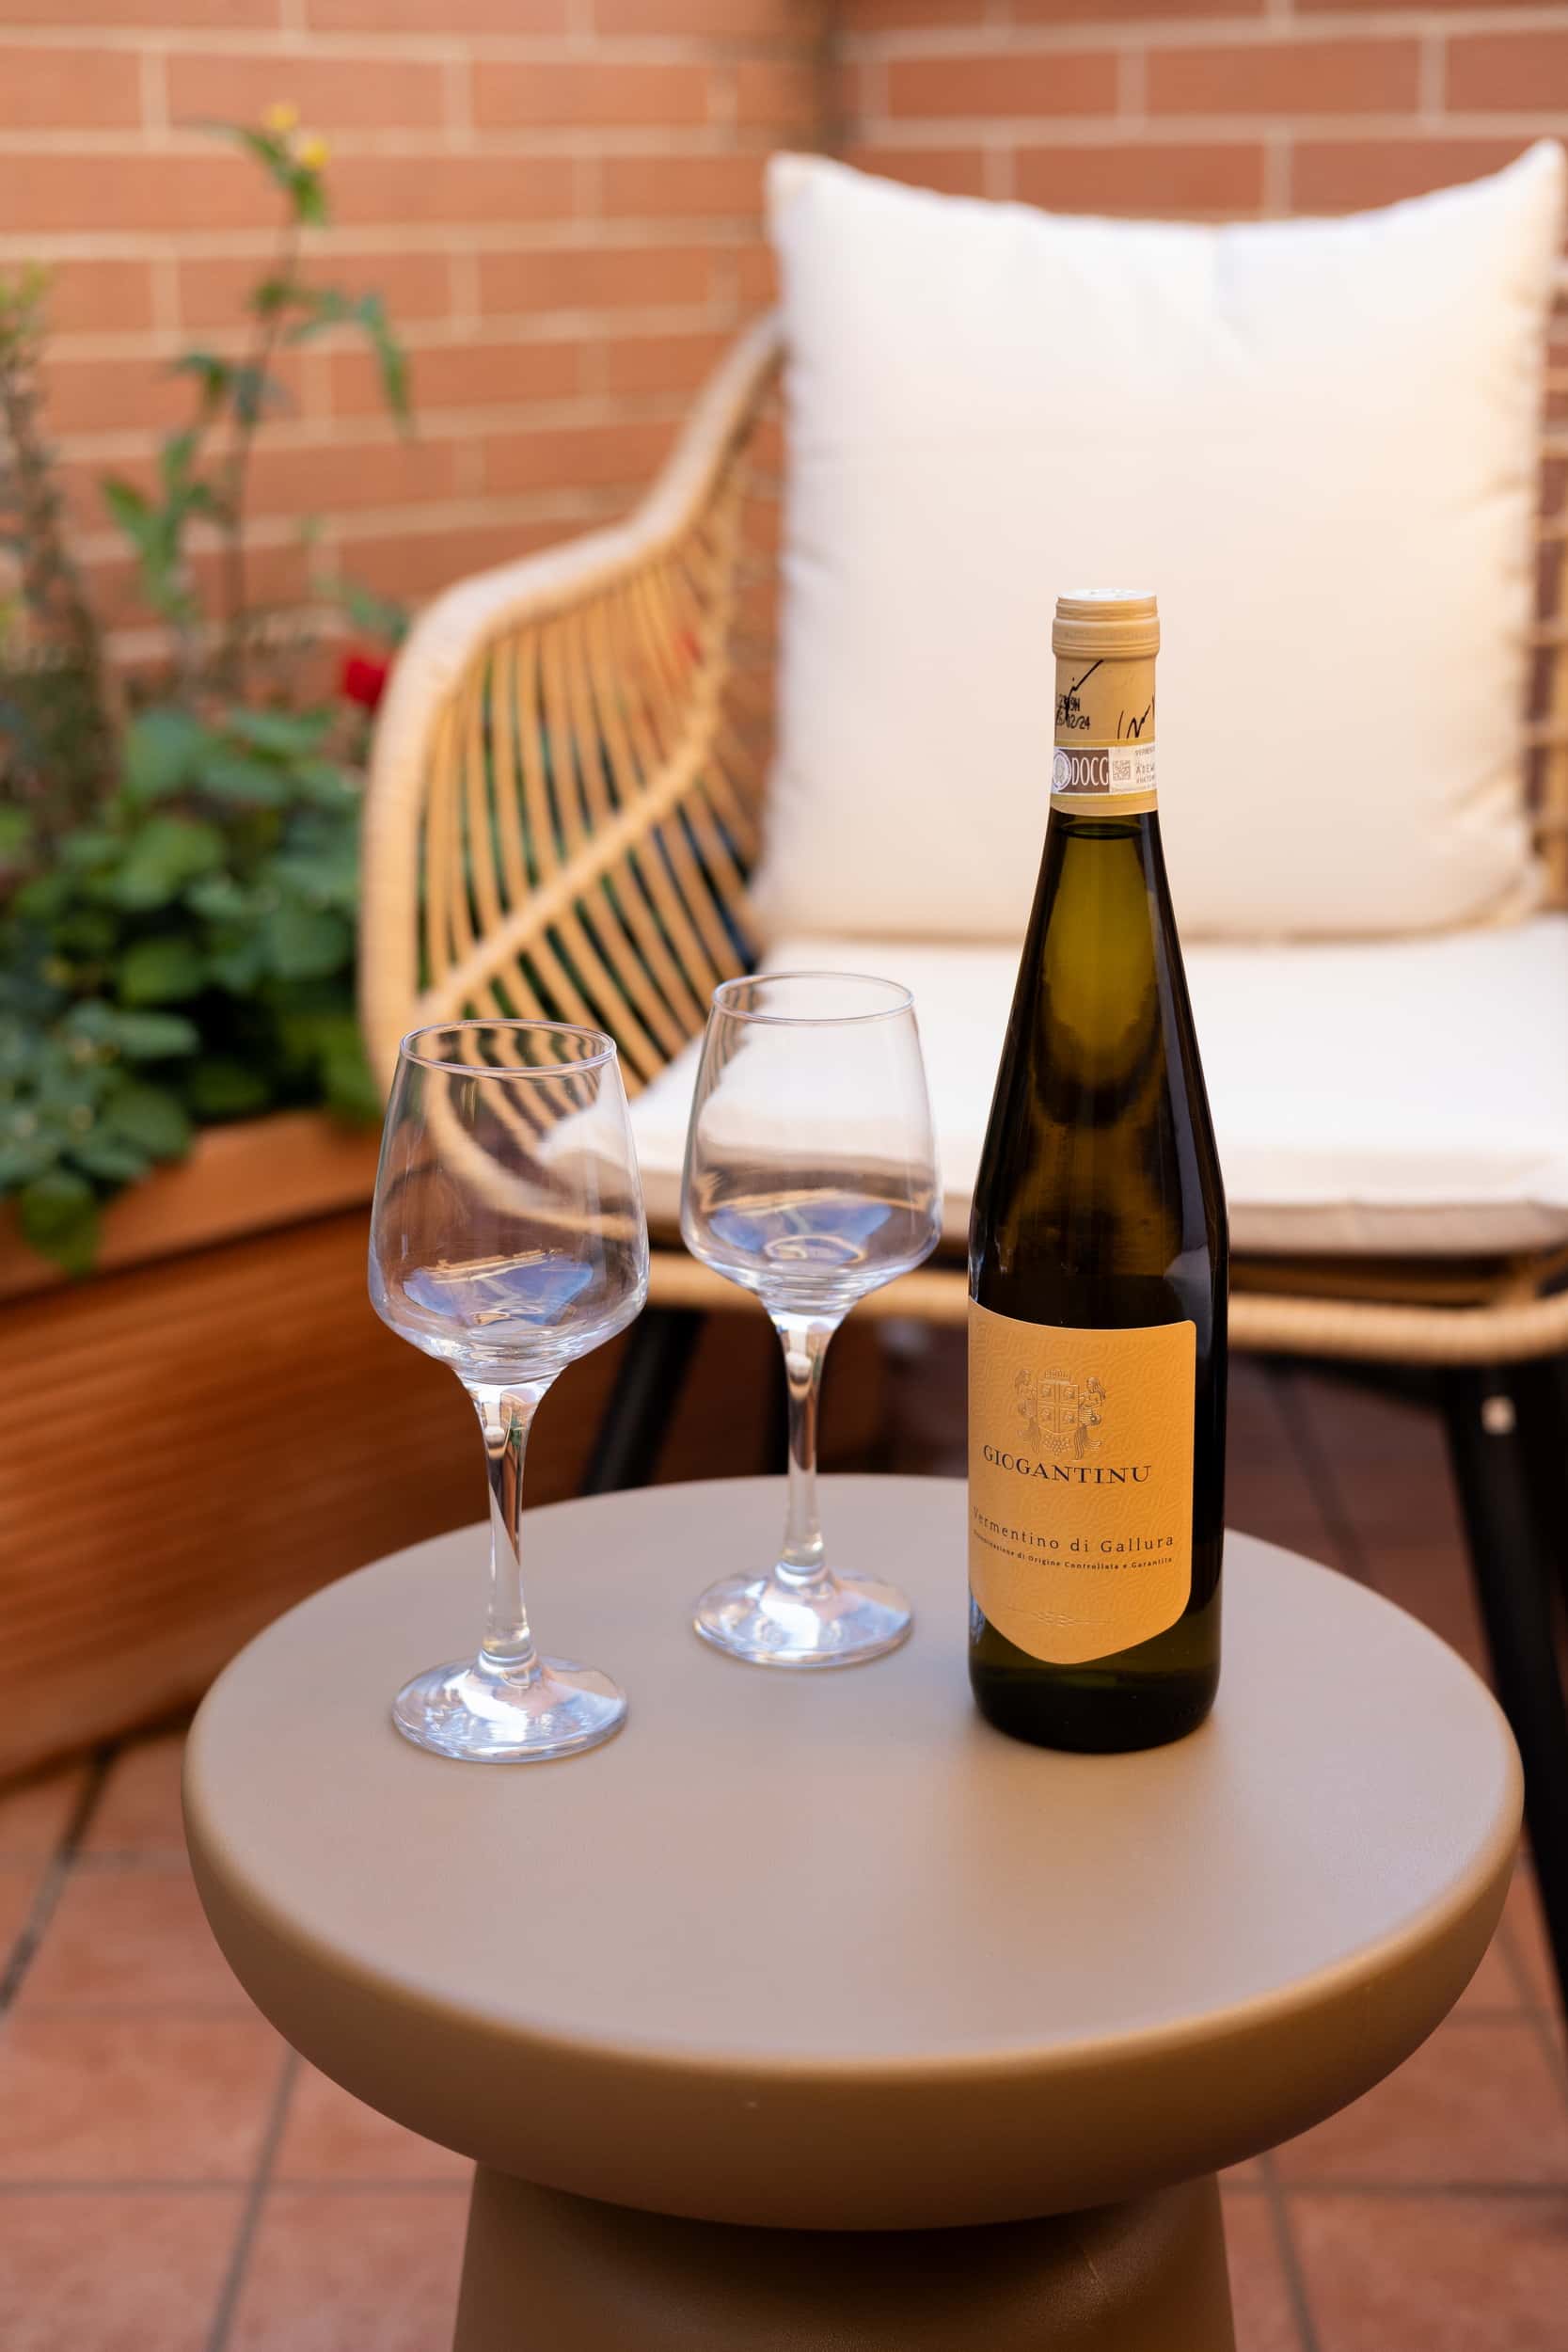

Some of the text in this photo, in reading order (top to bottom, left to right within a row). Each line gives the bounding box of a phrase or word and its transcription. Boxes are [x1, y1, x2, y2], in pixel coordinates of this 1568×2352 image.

[1071, 756, 1109, 786] DOCG
[983, 1444, 1151, 1484] GIOGANTINU
[972, 1505, 1059, 1549] Vermentino
[1070, 1537, 1088, 1552] di
[1101, 1536, 1174, 1553] Gallura
[1028, 1555, 1060, 1566] Origine
